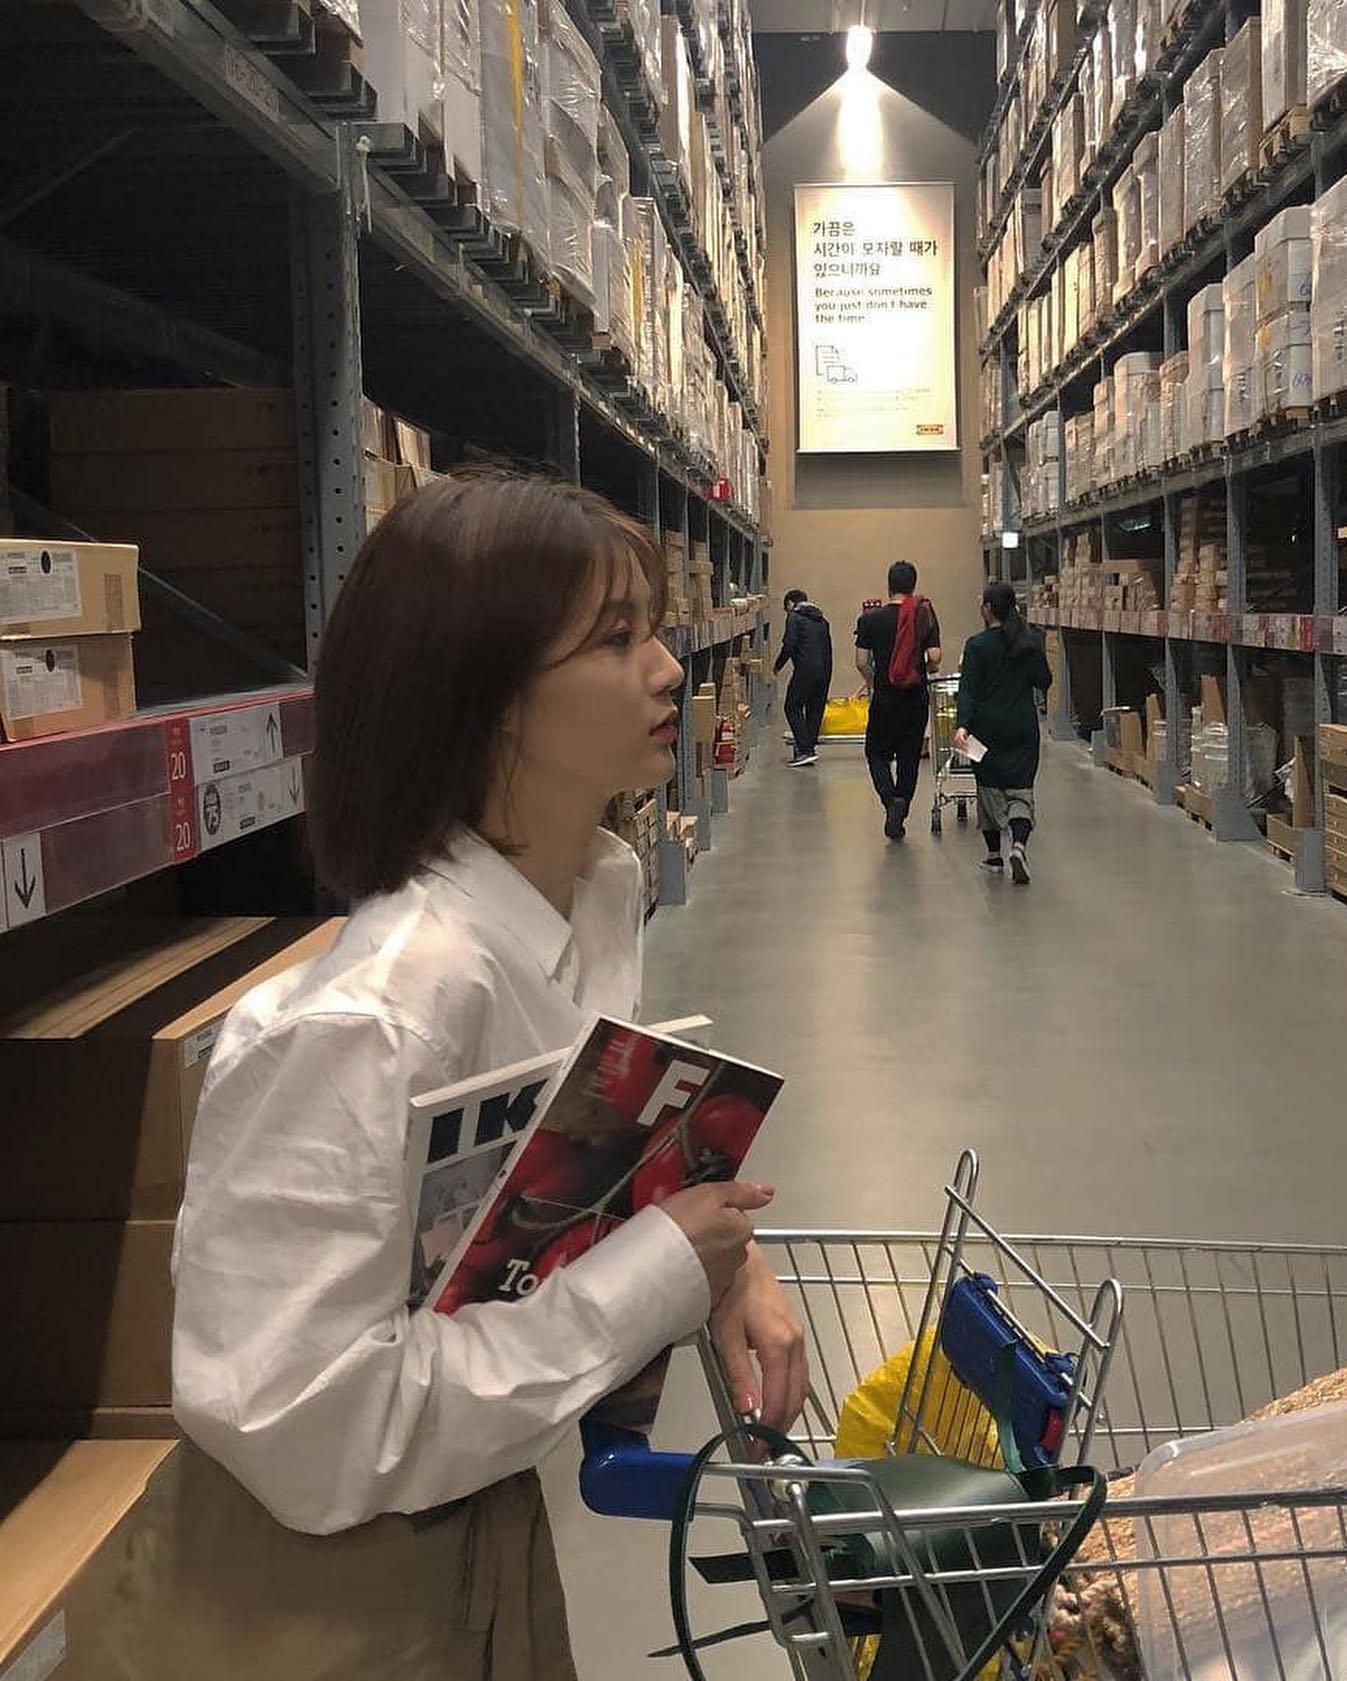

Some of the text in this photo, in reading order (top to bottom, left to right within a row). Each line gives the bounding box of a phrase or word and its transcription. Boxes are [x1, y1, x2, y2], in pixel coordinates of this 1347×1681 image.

[813, 221, 855, 237] 가끔은
[814, 242, 855, 258] 시간이
[909, 240, 938, 257] 때가
[814, 262, 881, 278] 있으니까요
[815, 287, 933, 298] Because sometimes
[815, 301, 836, 312] you
[840, 301, 862, 312] just
[899, 300, 928, 310] have
[815, 313, 834, 323] the
[171, 751, 187, 781] 20
[175, 821, 191, 851] 20
[637, 1059, 710, 1126] F
